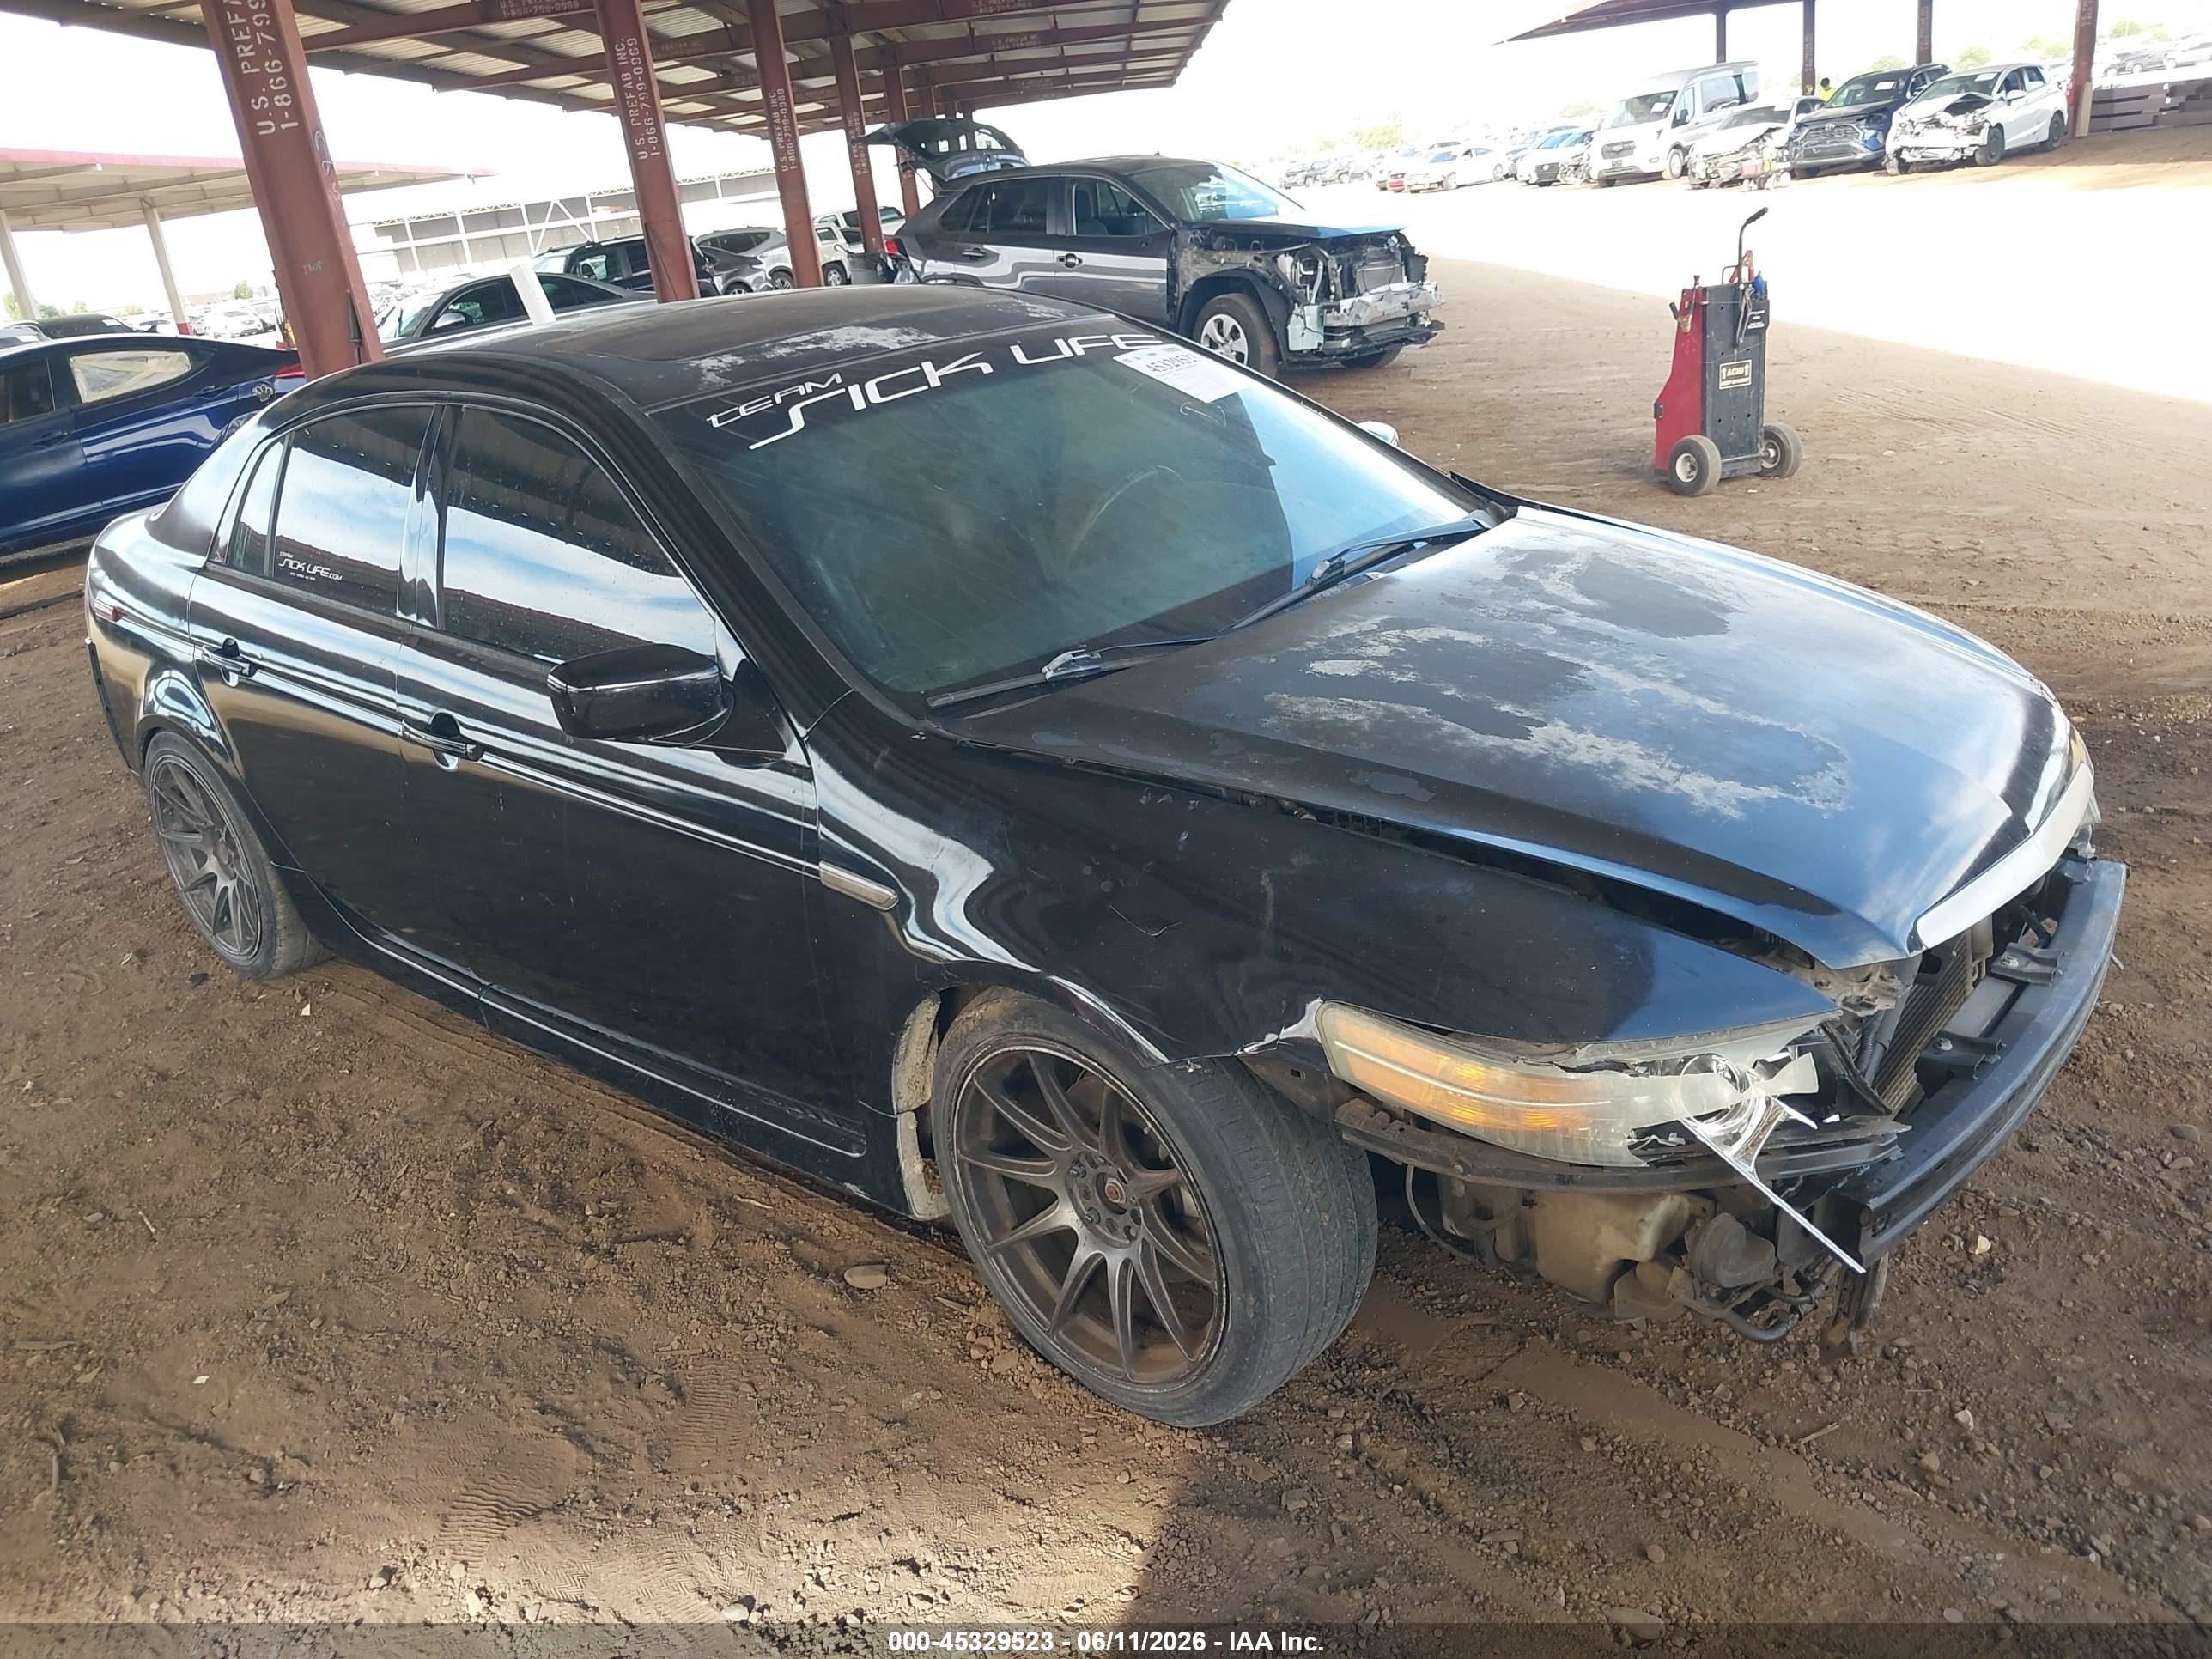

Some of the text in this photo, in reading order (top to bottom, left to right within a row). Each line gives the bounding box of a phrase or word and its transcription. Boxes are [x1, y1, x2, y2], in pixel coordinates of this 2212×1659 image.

[615, 38, 629, 65] INC.
[251, 88, 276, 136] U.S.
[621, 71, 642, 126] PREFAB
[627, 37, 661, 156] 1-866-799-0969
[749, 334, 1163, 450] SICK LIFE
